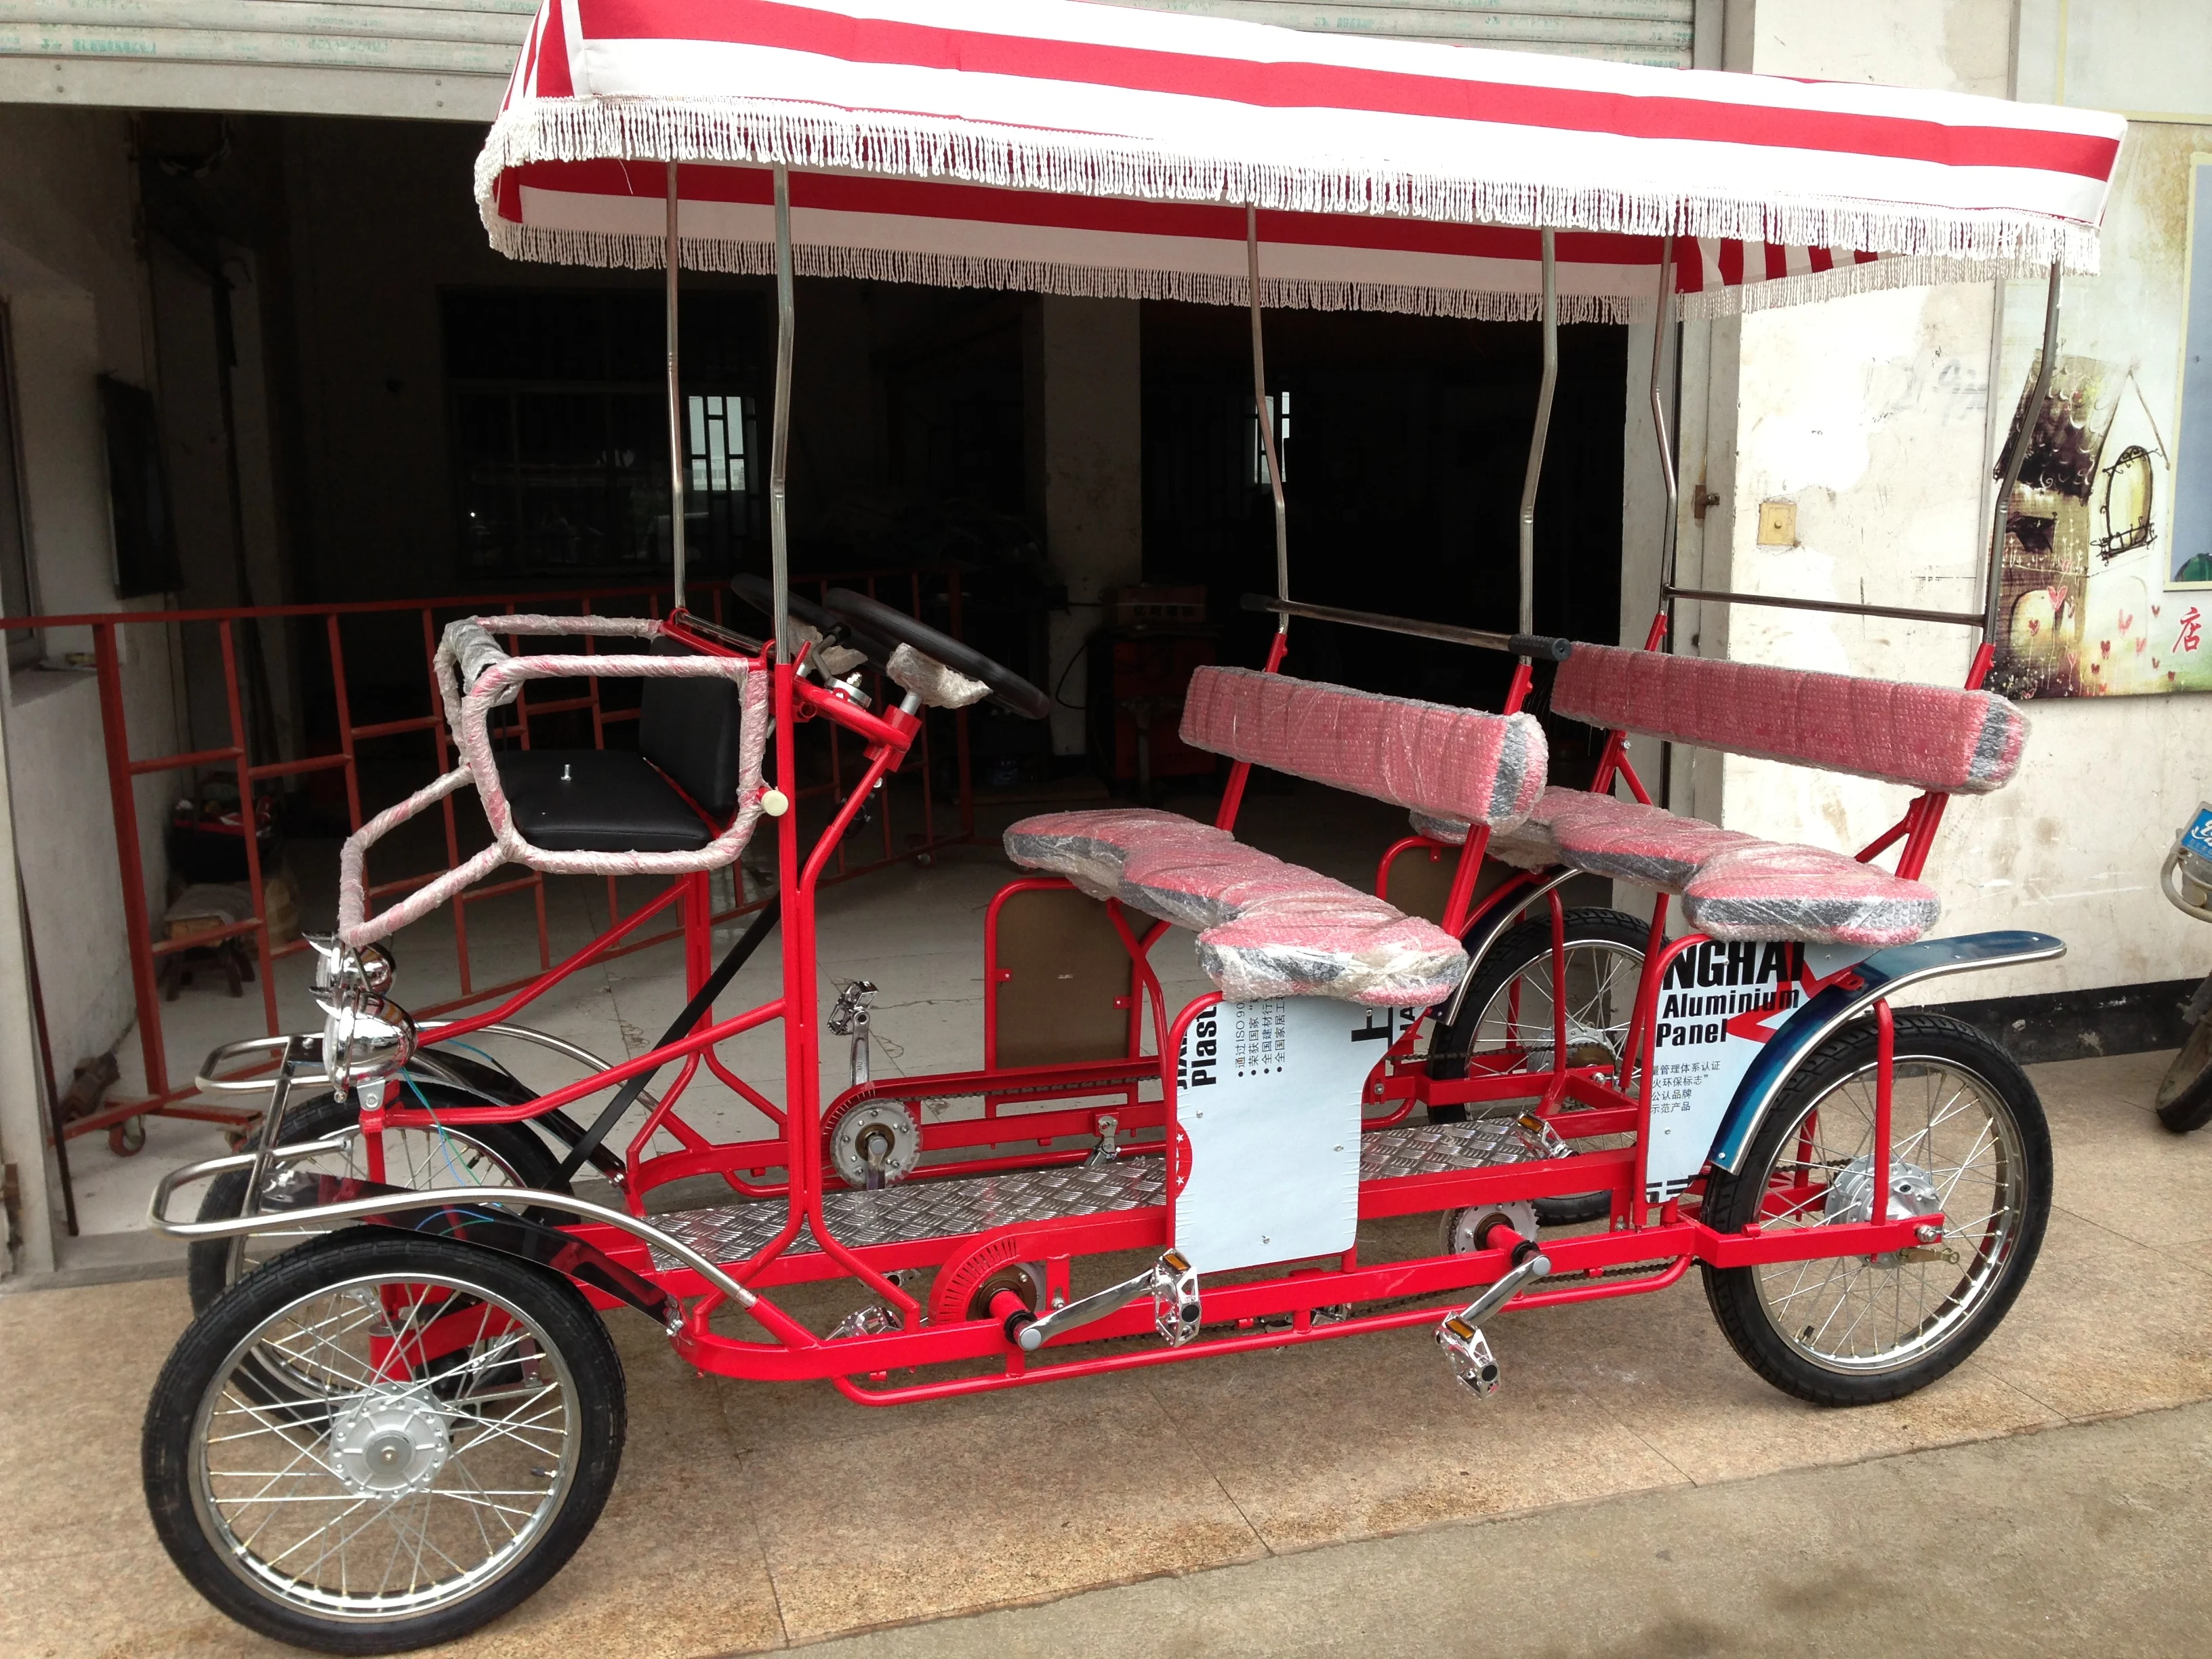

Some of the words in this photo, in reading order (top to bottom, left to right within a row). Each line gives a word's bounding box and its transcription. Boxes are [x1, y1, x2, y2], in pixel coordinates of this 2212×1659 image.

[2173, 607, 2202, 653] 店
[1662, 988, 1800, 1019] Aluminium
[1656, 1018, 1728, 1047] Panel
